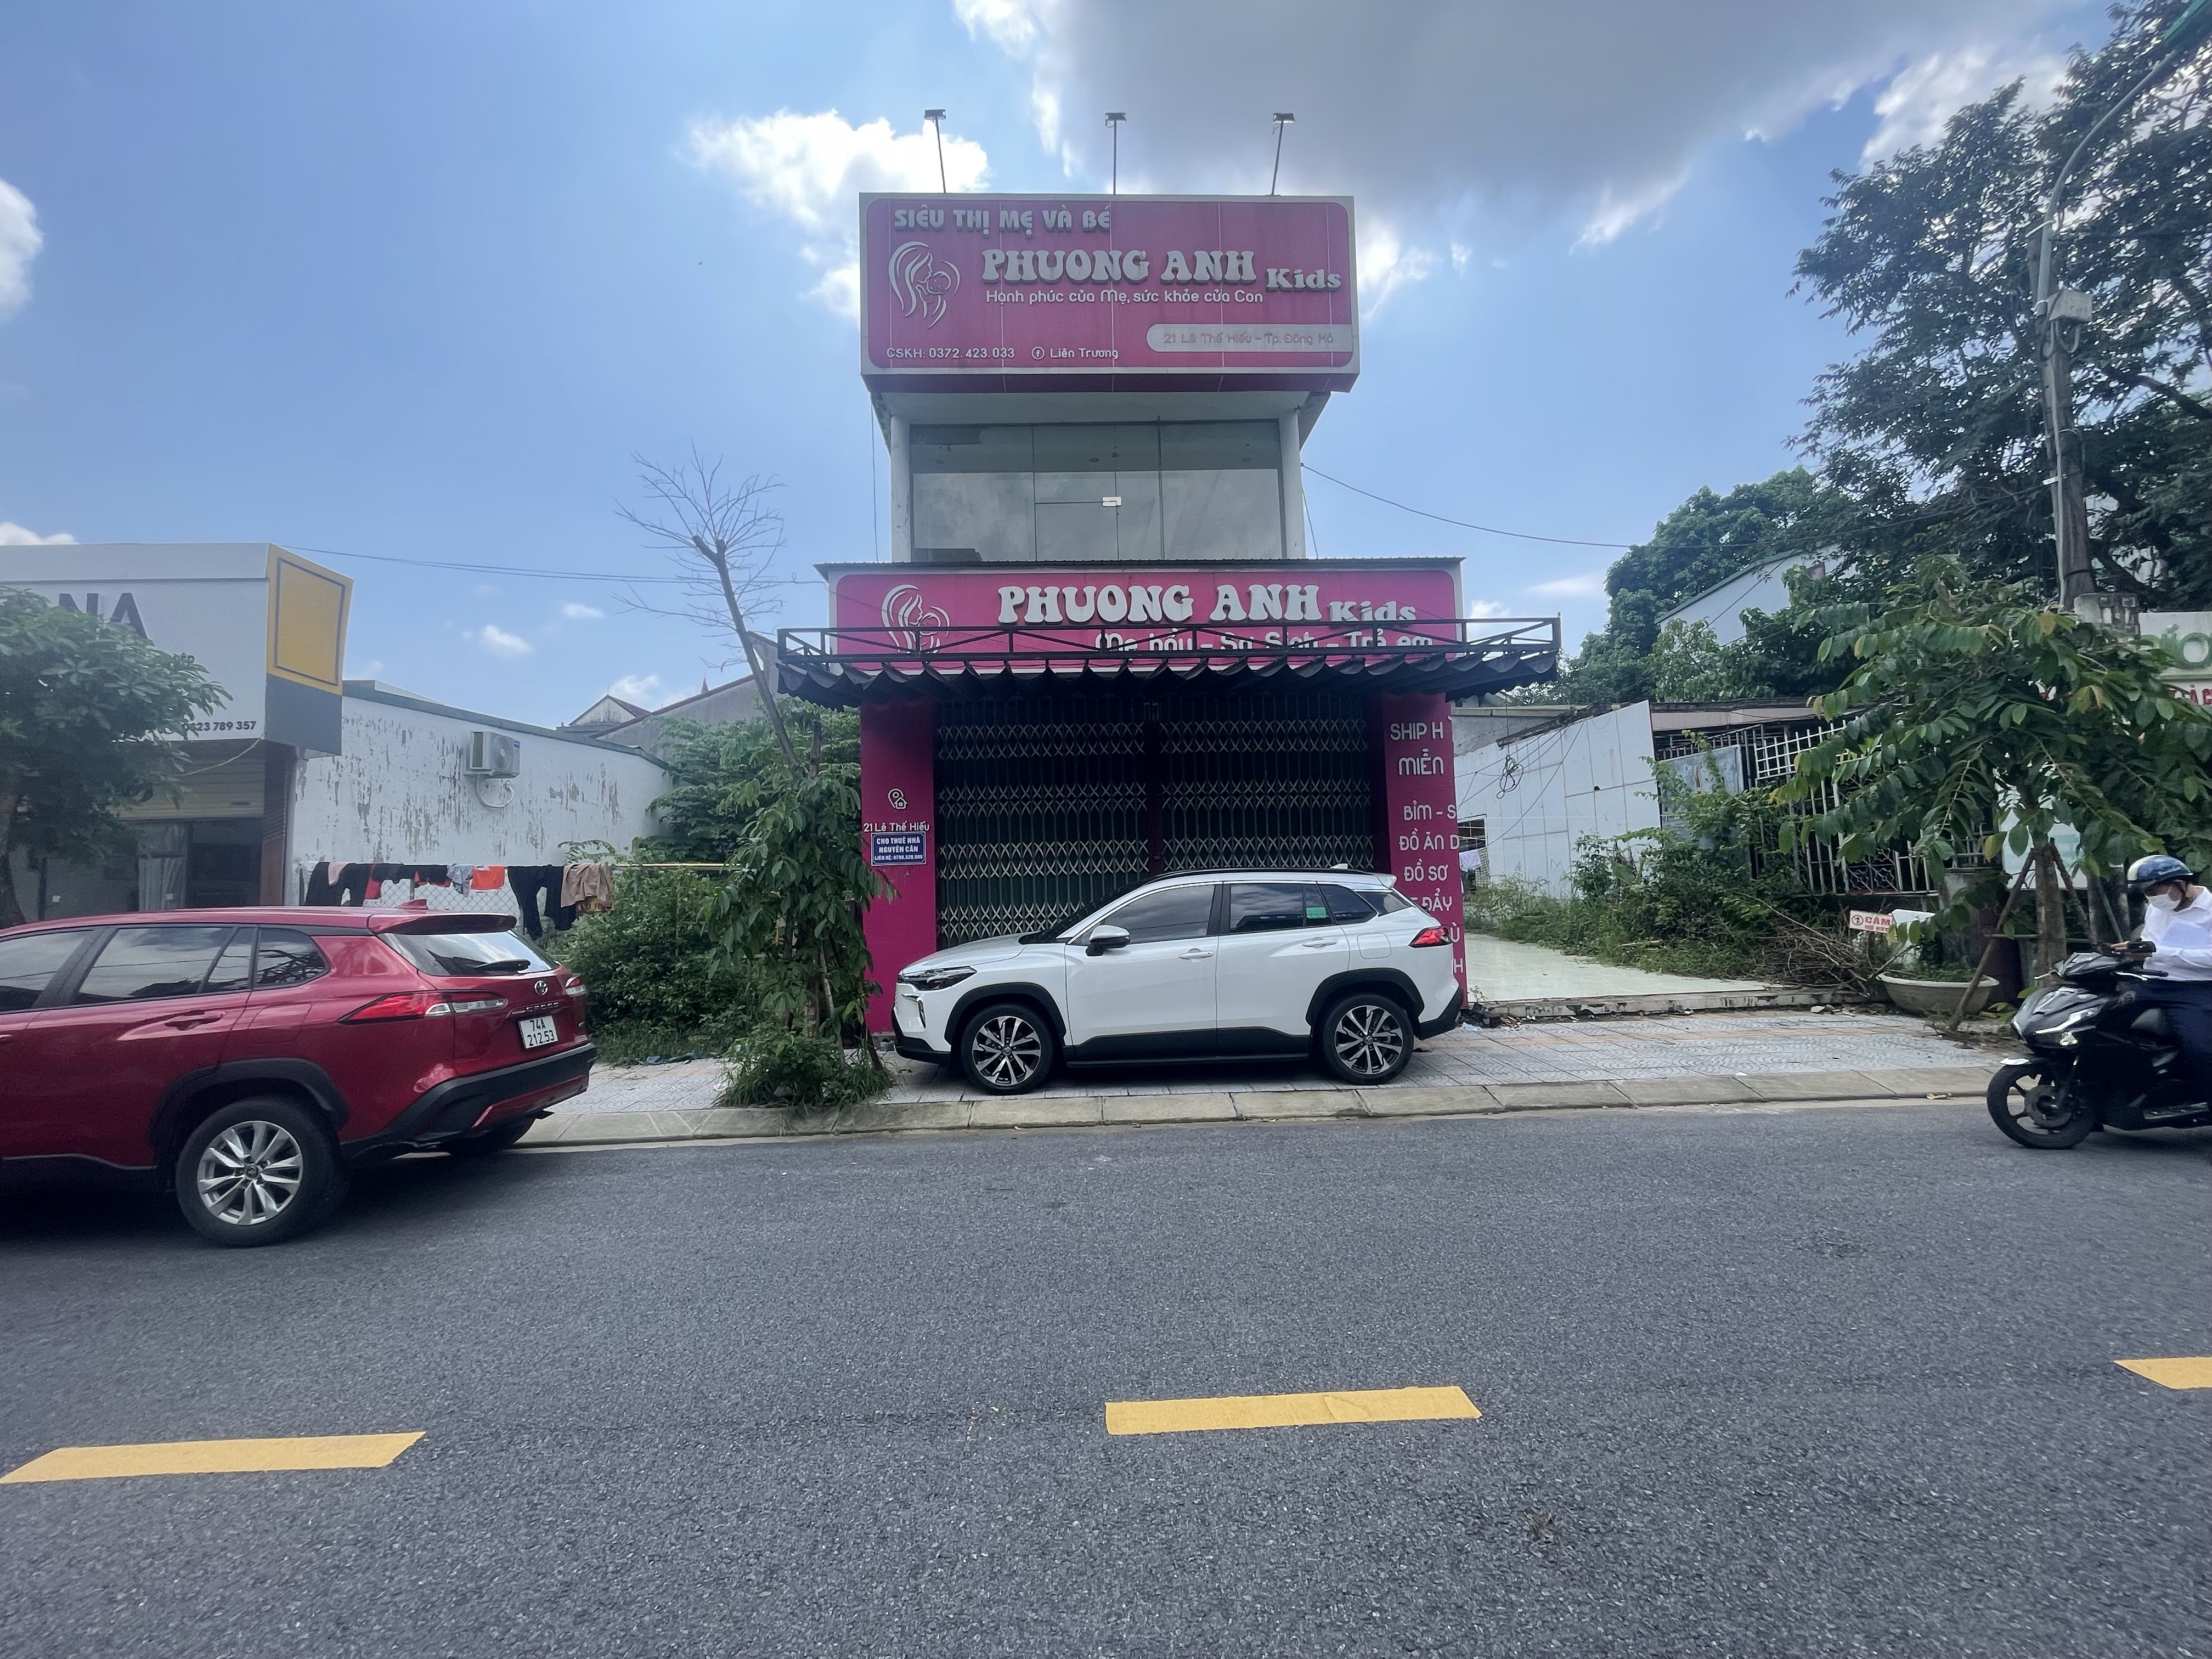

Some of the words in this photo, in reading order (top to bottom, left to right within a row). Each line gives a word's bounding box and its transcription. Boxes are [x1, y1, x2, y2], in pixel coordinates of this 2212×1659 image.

[894, 204, 944, 228] SIÊU
[953, 210, 990, 235] THỊ
[999, 210, 1032, 236] MẸ
[1042, 204, 1072, 229] VÀ
[1082, 205, 1110, 229] BÉ
[982, 249, 1149, 281] PHUONG
[1160, 250, 1256, 282] ANH
[1266, 268, 1341, 290] Kids
[986, 290, 1024, 304] Hạnh
[1029, 289, 1064, 304] phúc
[1069, 289, 1095, 303] của
[1101, 290, 1130, 304] Mẹ,
[1133, 289, 1159, 303] sức
[1165, 289, 1199, 303] khỏe
[1204, 289, 1230, 303] của
[1234, 290, 1263, 303] Con
[1164, 334, 1176, 343] 21
[1181, 333, 1196, 343] Lê
[1201, 332, 1223, 343] Thế
[1227, 332, 1251, 343] Hiếu
[1264, 333, 1281, 345] Tp.
[1318, 333, 1334, 343] Hà
[887, 348, 925, 359] CSKH:
[1050, 347, 1075, 358] Liên
[1078, 348, 1119, 359] Trương
[998, 585, 1194, 623] PHUONG
[1210, 584, 1322, 621] ANH
[1328, 601, 1416, 622] Kids
[213, 721, 233, 731] 789
[236, 721, 256, 730] 357
[1390, 722, 1427, 740] SHIP
[1403, 800, 1431, 821] BỈM
[864, 823, 872, 832] 21
[875, 822, 887, 832] Lê
[890, 820, 907, 832] Thế
[910, 821, 929, 831] Hiếu
[1399, 827, 1419, 850] ĐỒ
[1424, 831, 1444, 850] ĂN
[1404, 858, 1424, 881] ĐỒ
[1428, 865, 1448, 881] SƠ
[529, 1018, 546, 1031] 74A
[527, 1030, 554, 1046] 212.53
